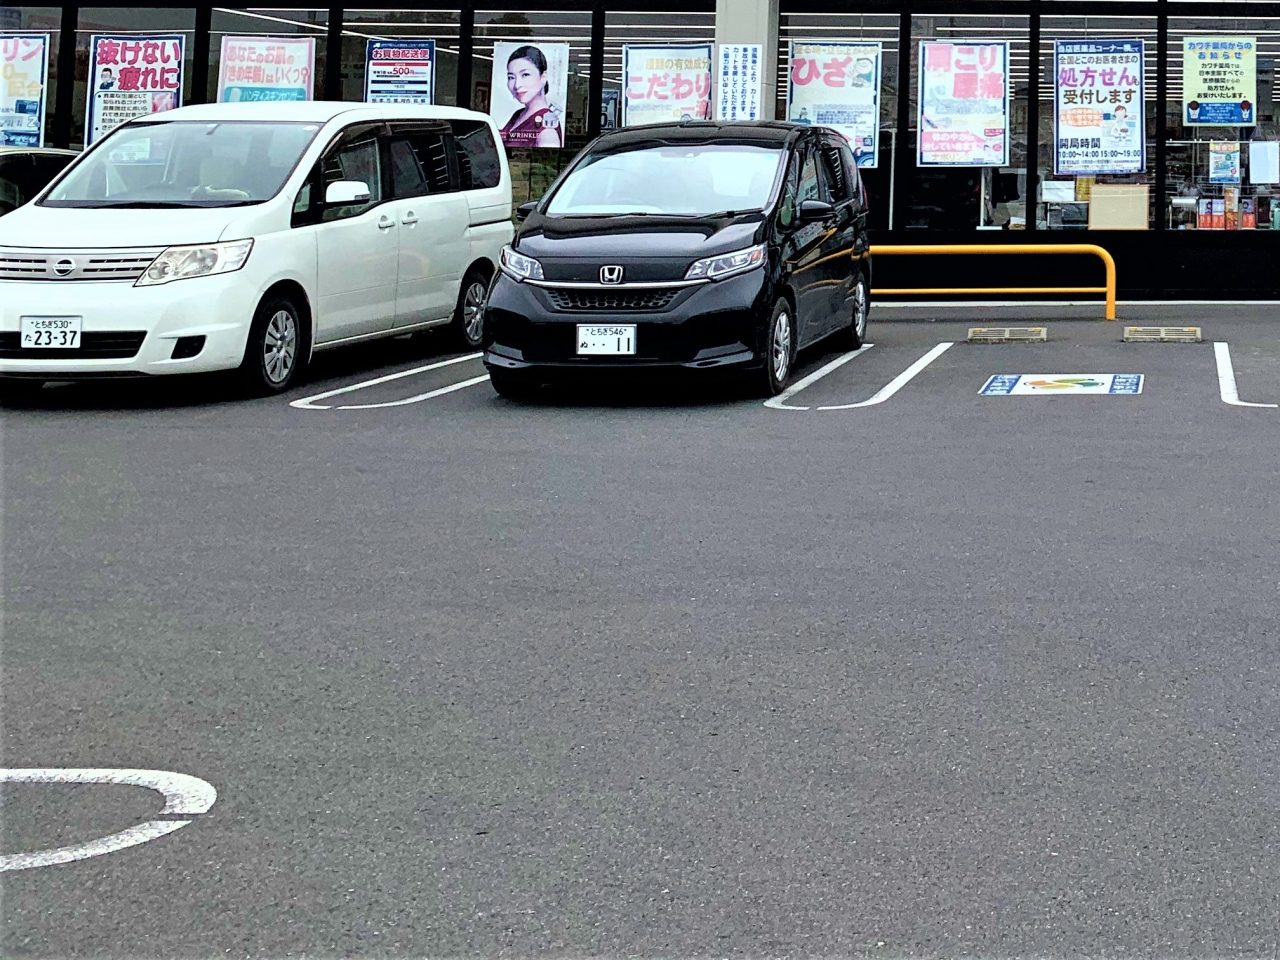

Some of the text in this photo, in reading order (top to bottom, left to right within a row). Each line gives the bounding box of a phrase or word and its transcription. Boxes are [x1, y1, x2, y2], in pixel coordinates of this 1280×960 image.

[97, 40, 181, 65] 抜けない
[372, 49, 430, 60] お買物配送便
[1059, 55, 1138, 65] 全国どこのお医者さまの
[118, 67, 180, 91] 疲れに
[792, 56, 853, 88] ひざ
[628, 72, 711, 100] こだわり
[1063, 88, 1137, 105] 受付します
[1059, 137, 1101, 149] 開局時間
[34, 320, 69, 329] とちぎ530
[590, 327, 624, 336] とちぎ546
[24, 330, 78, 346] た 23-37
